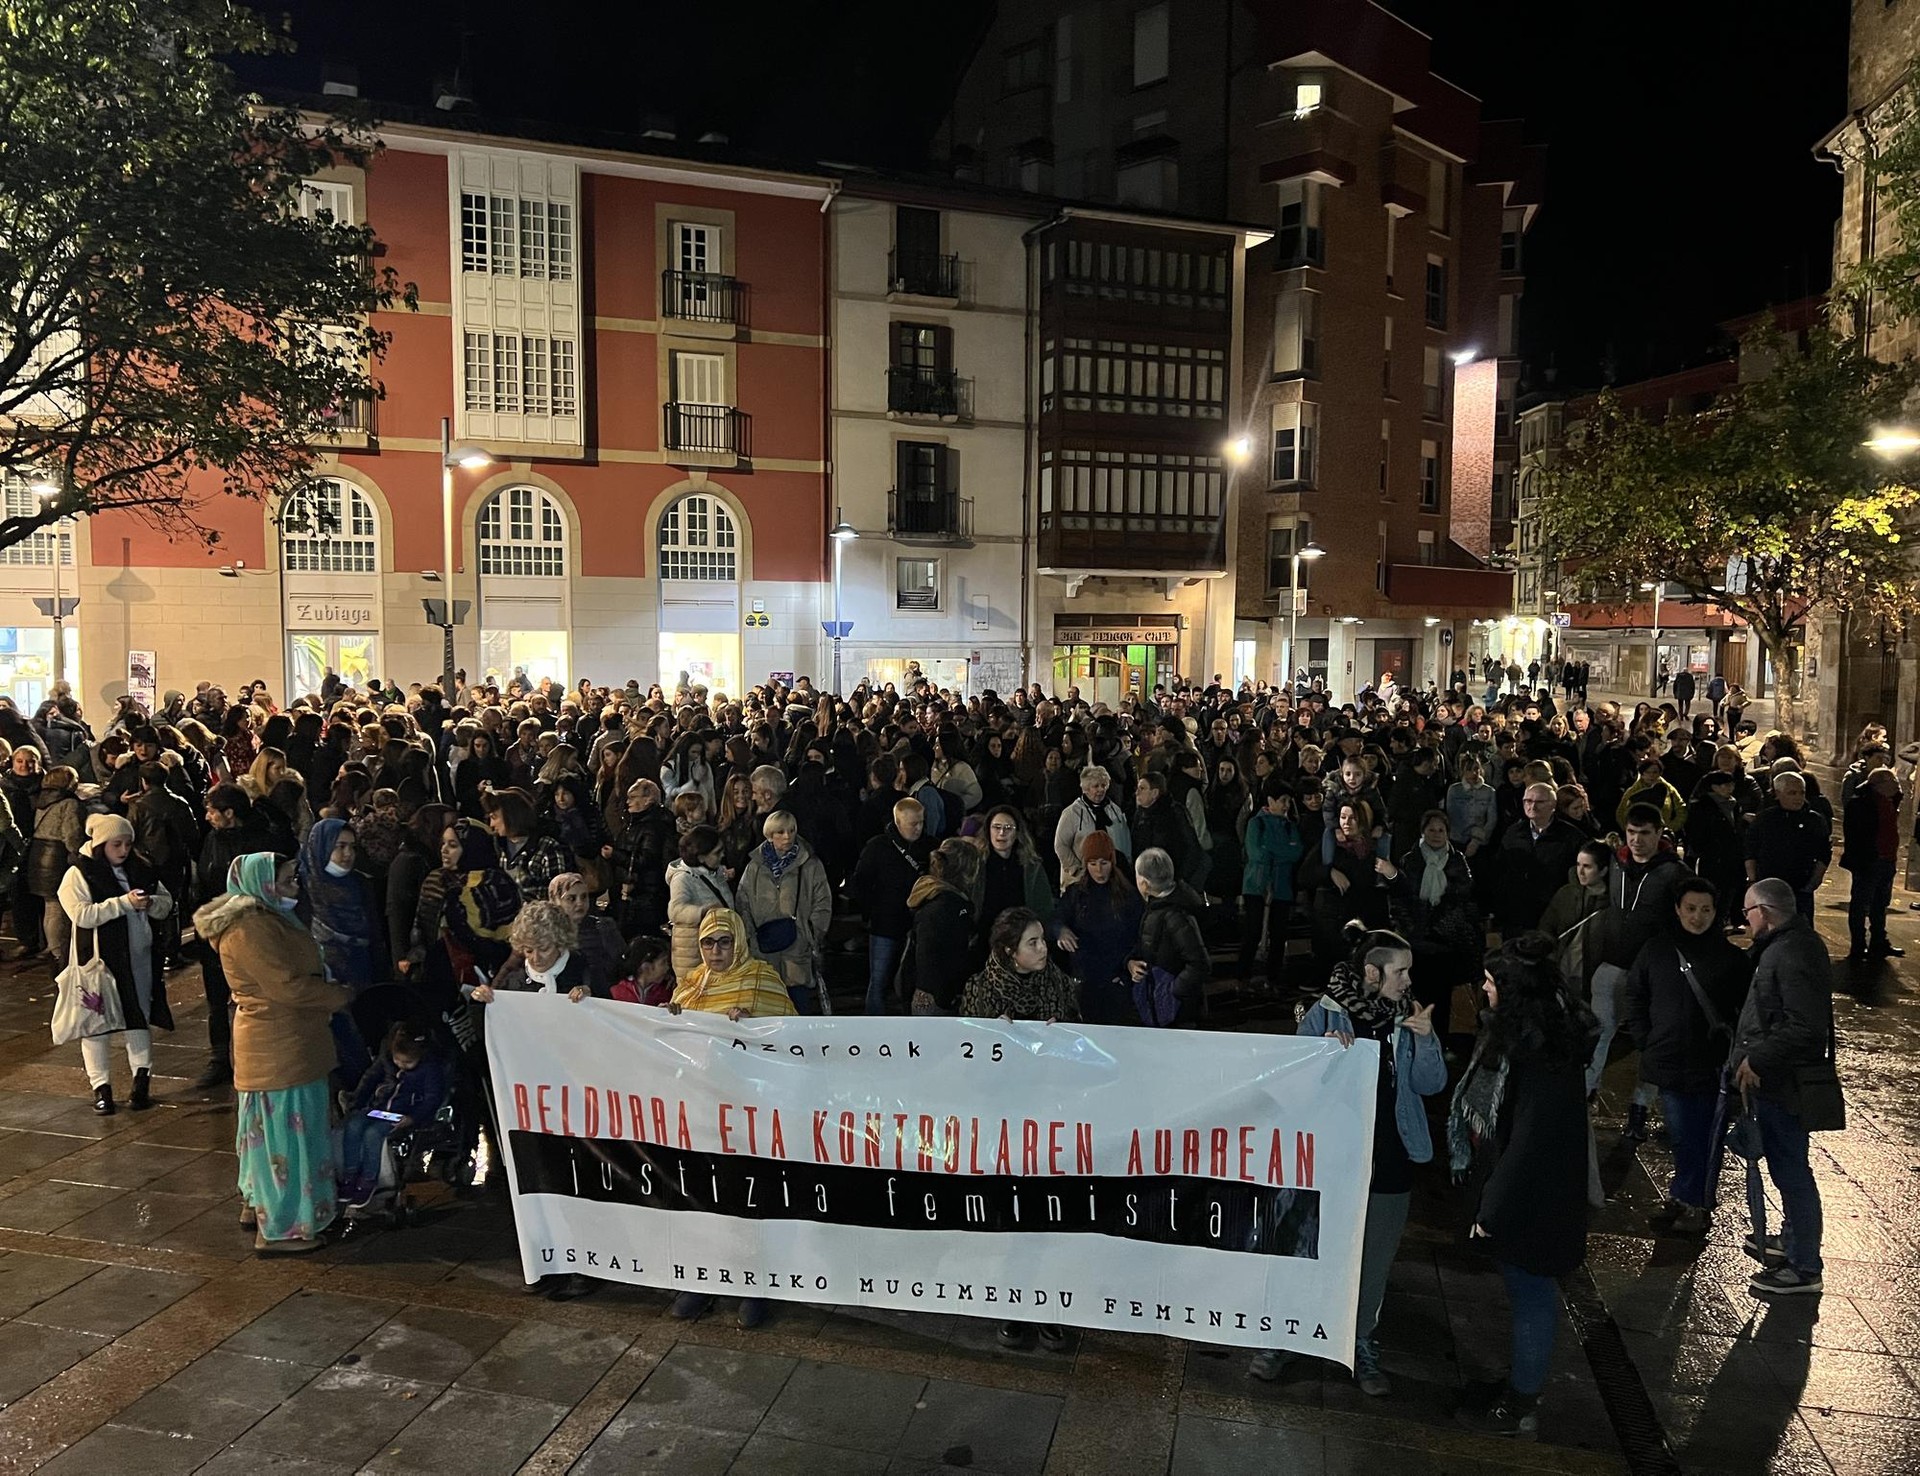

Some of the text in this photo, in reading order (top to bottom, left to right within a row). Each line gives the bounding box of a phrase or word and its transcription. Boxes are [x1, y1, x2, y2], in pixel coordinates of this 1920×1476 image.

[297, 604, 370, 625] Zubiaga
[960, 1041, 1004, 1062] 25
[514, 1083, 1315, 1188] BELDURRA ETA KONTROLAREN AURREAN
[570, 1148, 1259, 1242] justizia feminista!
[541, 1248, 1328, 1340] USKAL HERRIKO MUGIMENDU FEMINISTA
